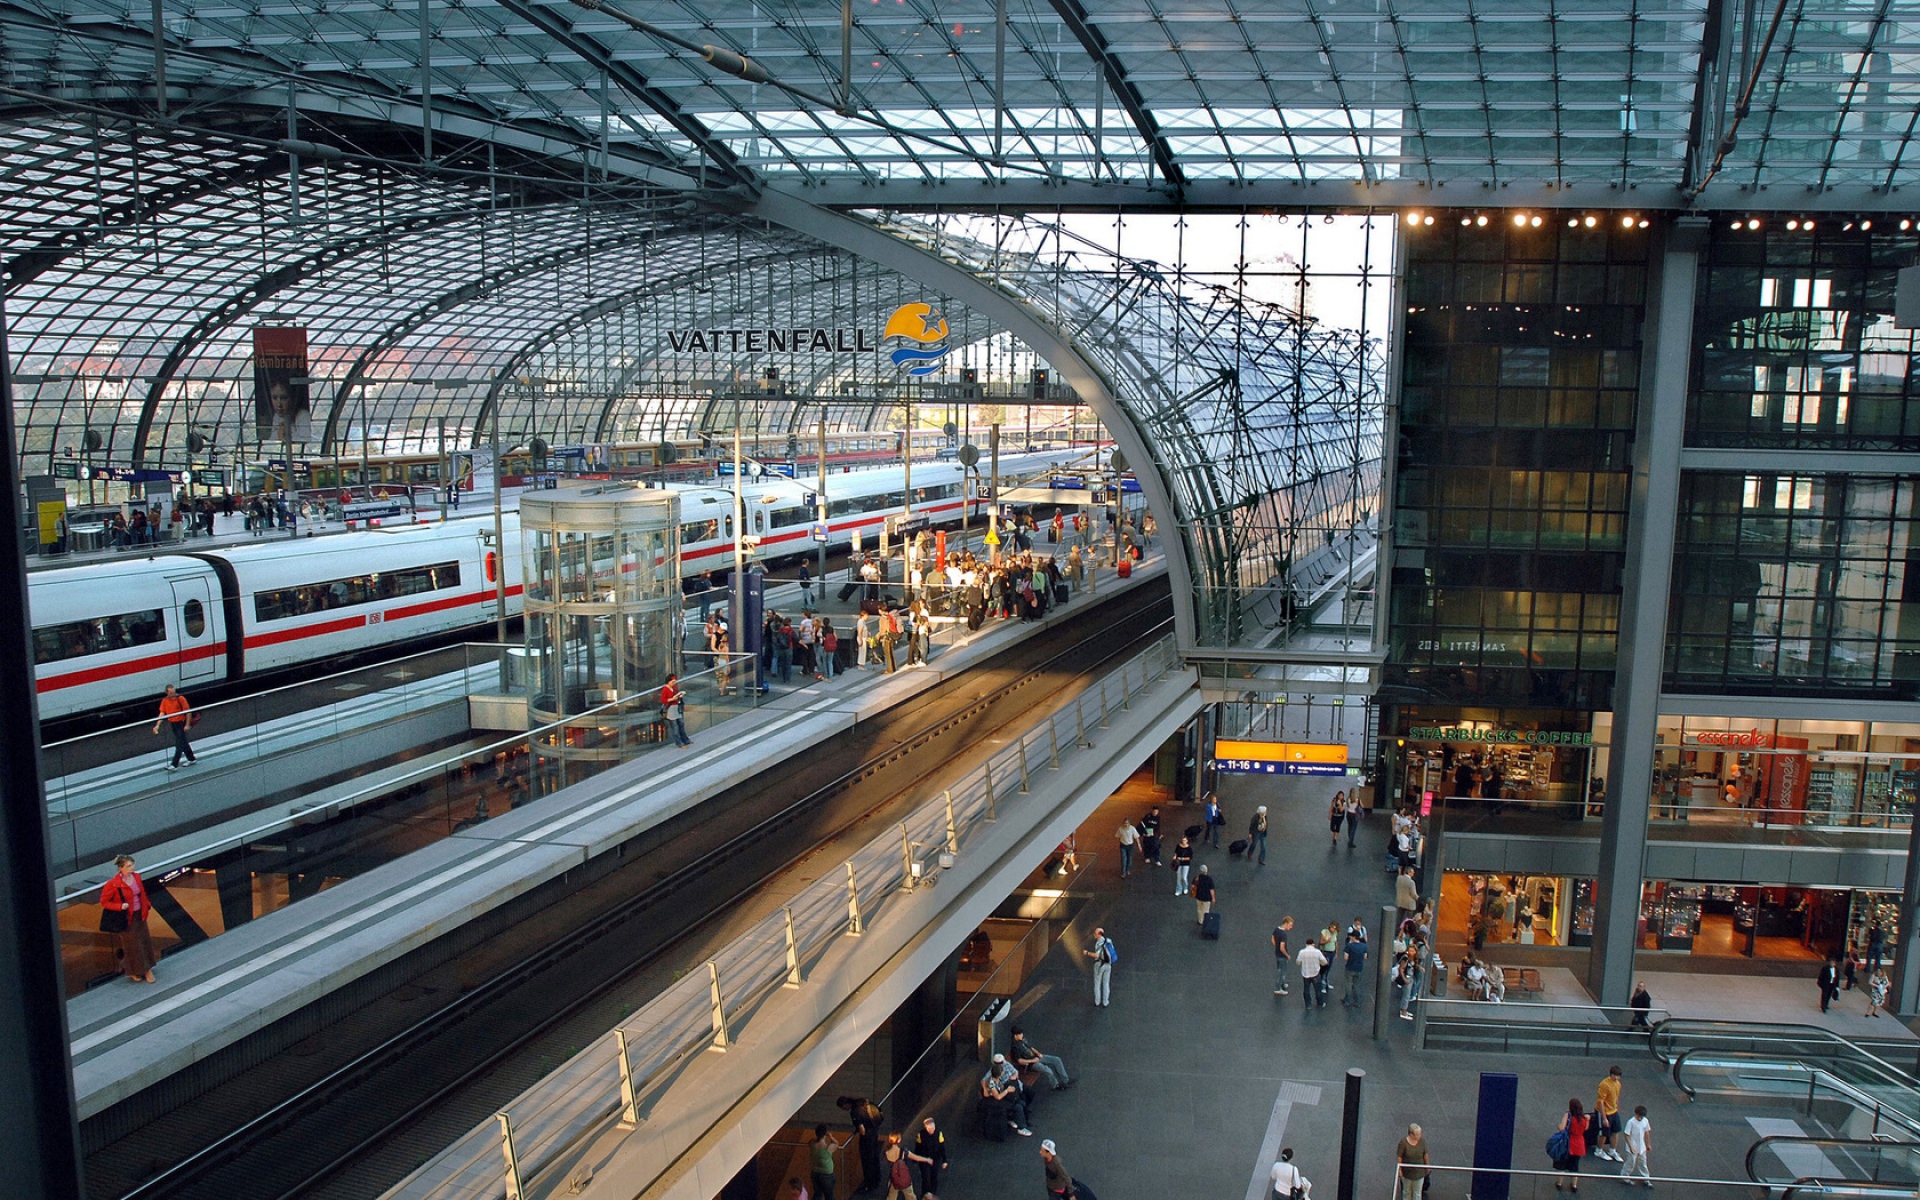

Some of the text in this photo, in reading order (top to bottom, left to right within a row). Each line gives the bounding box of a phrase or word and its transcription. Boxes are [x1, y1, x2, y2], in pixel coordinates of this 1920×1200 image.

[667, 328, 875, 353] VATTENFALL
[278, 489, 283, 499] F
[451, 492, 457, 500] F
[979, 487, 989, 497] 12
[804, 494, 811, 504] F
[1096, 493, 1105, 502] 11
[1004, 504, 1012, 516] F
[1409, 726, 1593, 745] STARBUCKS COFFEE
[1697, 728, 1766, 746] essanelle
[1227, 760, 1250, 769] 11-16
